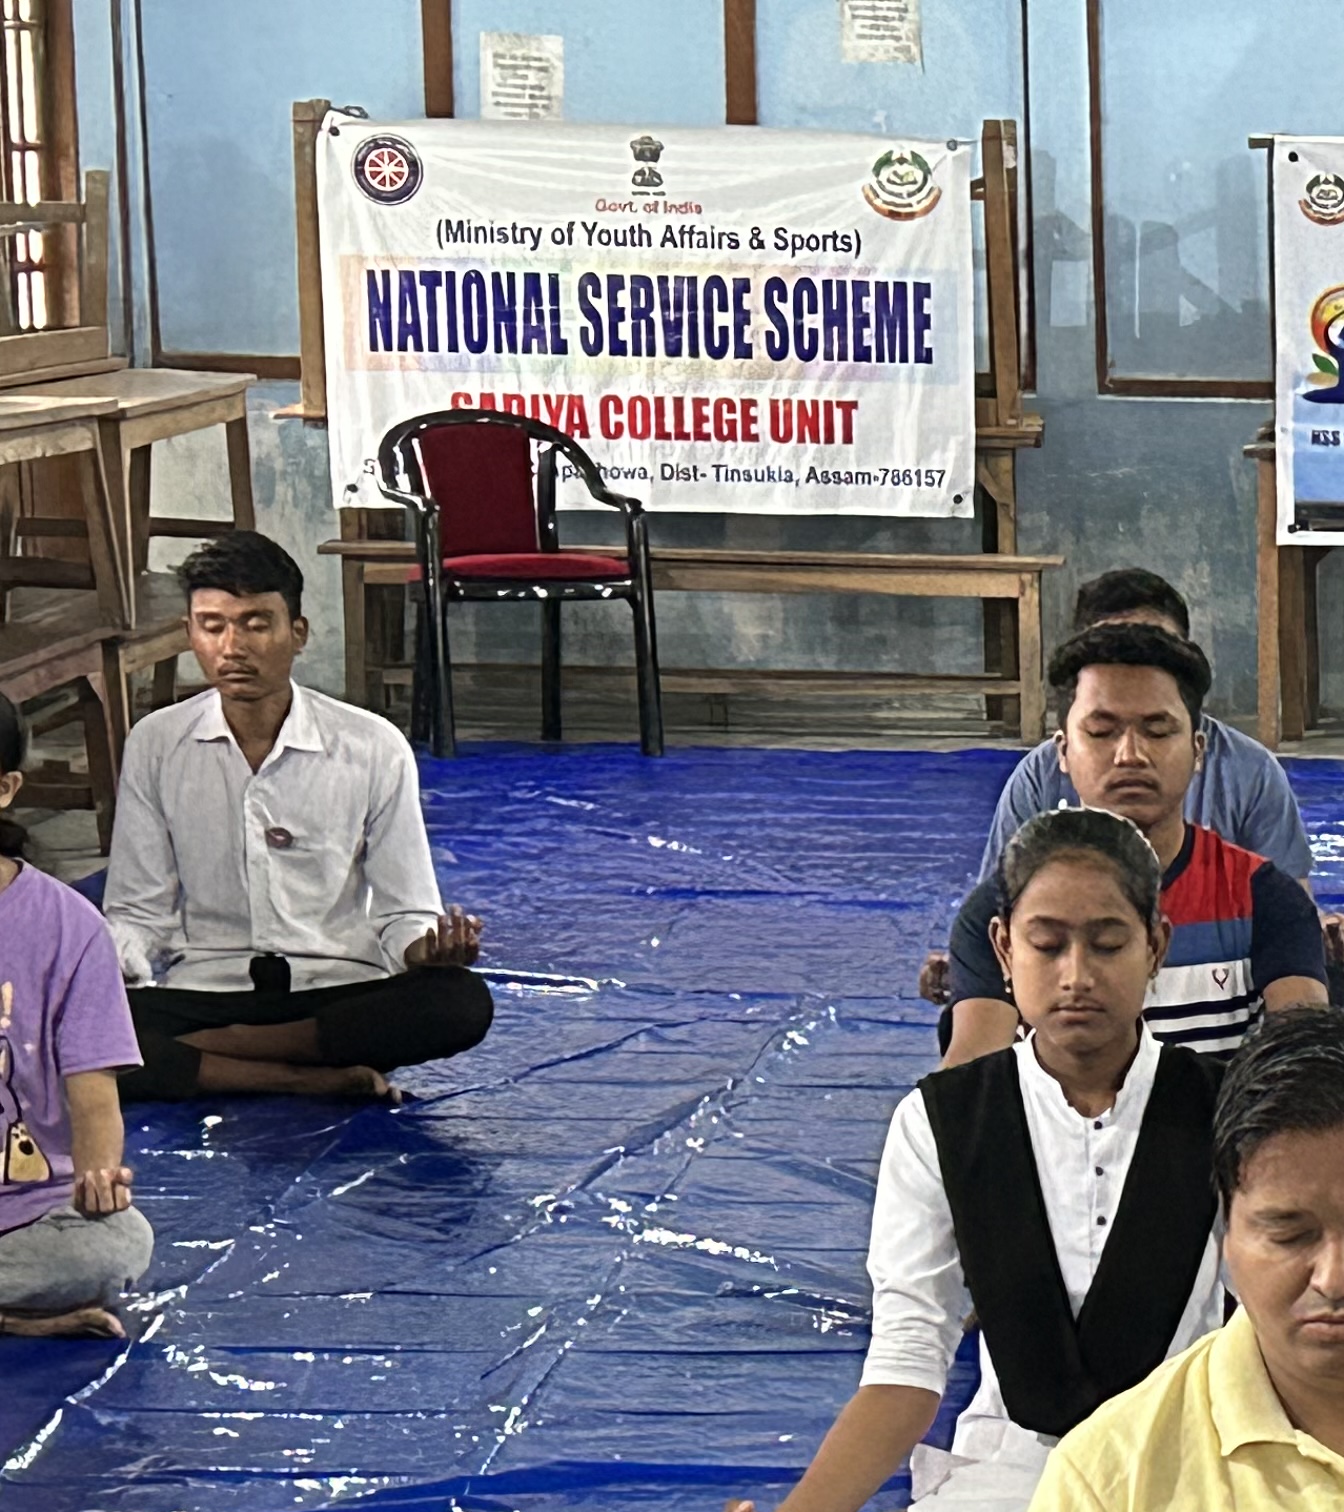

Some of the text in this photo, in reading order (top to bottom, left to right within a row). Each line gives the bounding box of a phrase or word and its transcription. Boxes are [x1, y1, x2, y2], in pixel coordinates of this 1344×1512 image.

[663, 200, 703, 215] India
[436, 219, 862, 259] (Ministry of Youth Affairs & Sports)
[366, 269, 934, 366] NATIONAL SERVICE SCHEME
[600, 394, 760, 443] COLLEGE
[769, 398, 858, 445] UNIT
[712, 464, 800, 488] Tinsukia,
